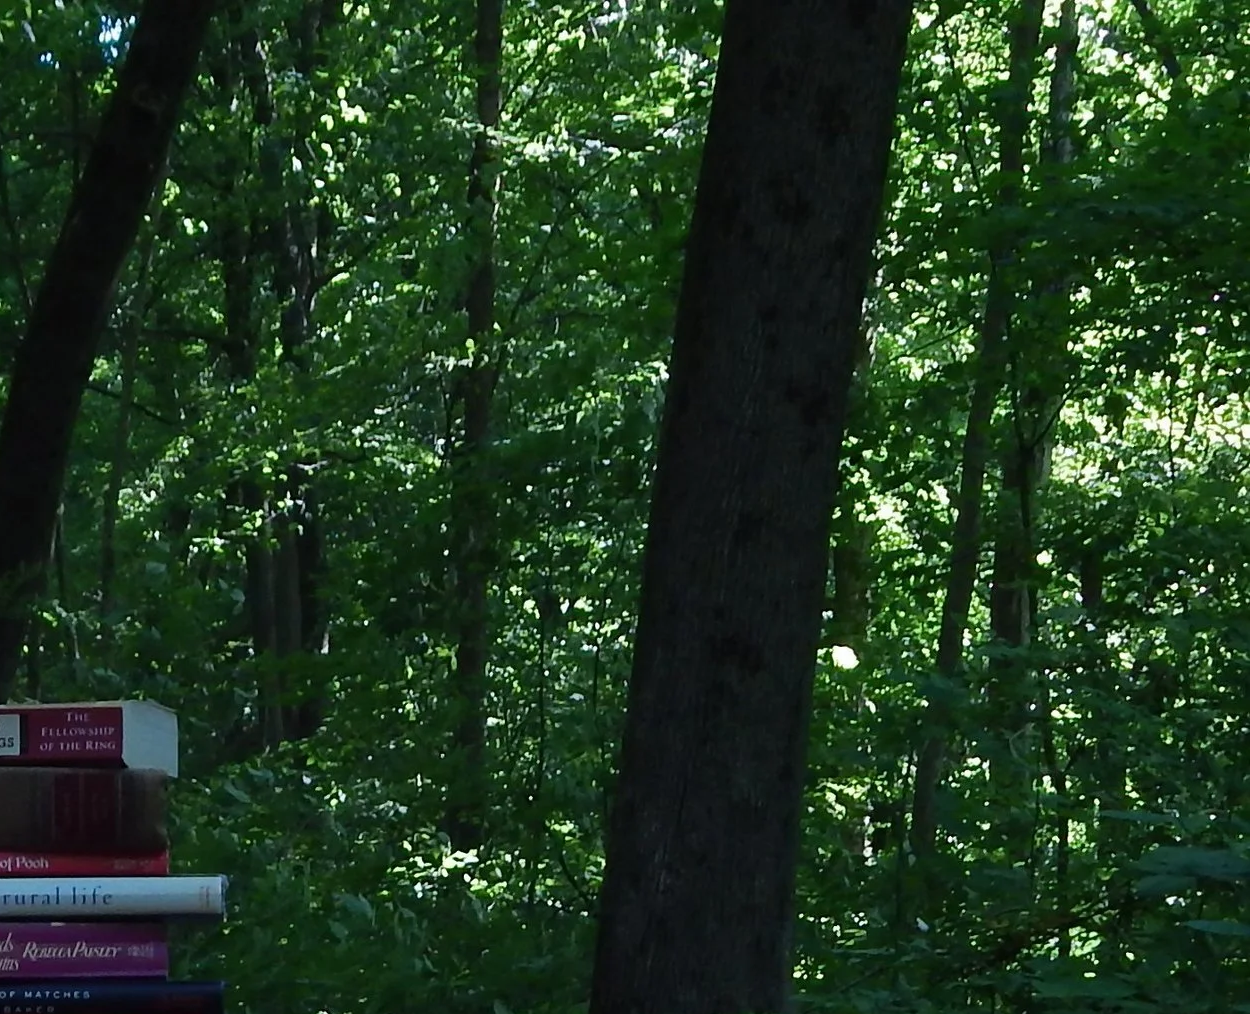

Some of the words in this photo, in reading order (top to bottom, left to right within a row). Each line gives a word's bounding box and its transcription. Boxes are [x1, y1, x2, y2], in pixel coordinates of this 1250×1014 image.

[65, 712, 90, 723] THE
[41, 726, 115, 738] FELLOWSHIP
[85, 739, 117, 751] RING
[0, 855, 13, 872] of
[16, 855, 50, 869] Pooh
[2, 886, 61, 905] rural
[72, 885, 113, 905] life
[0, 991, 16, 1000] OF
[24, 990, 91, 1000] MATCHES
